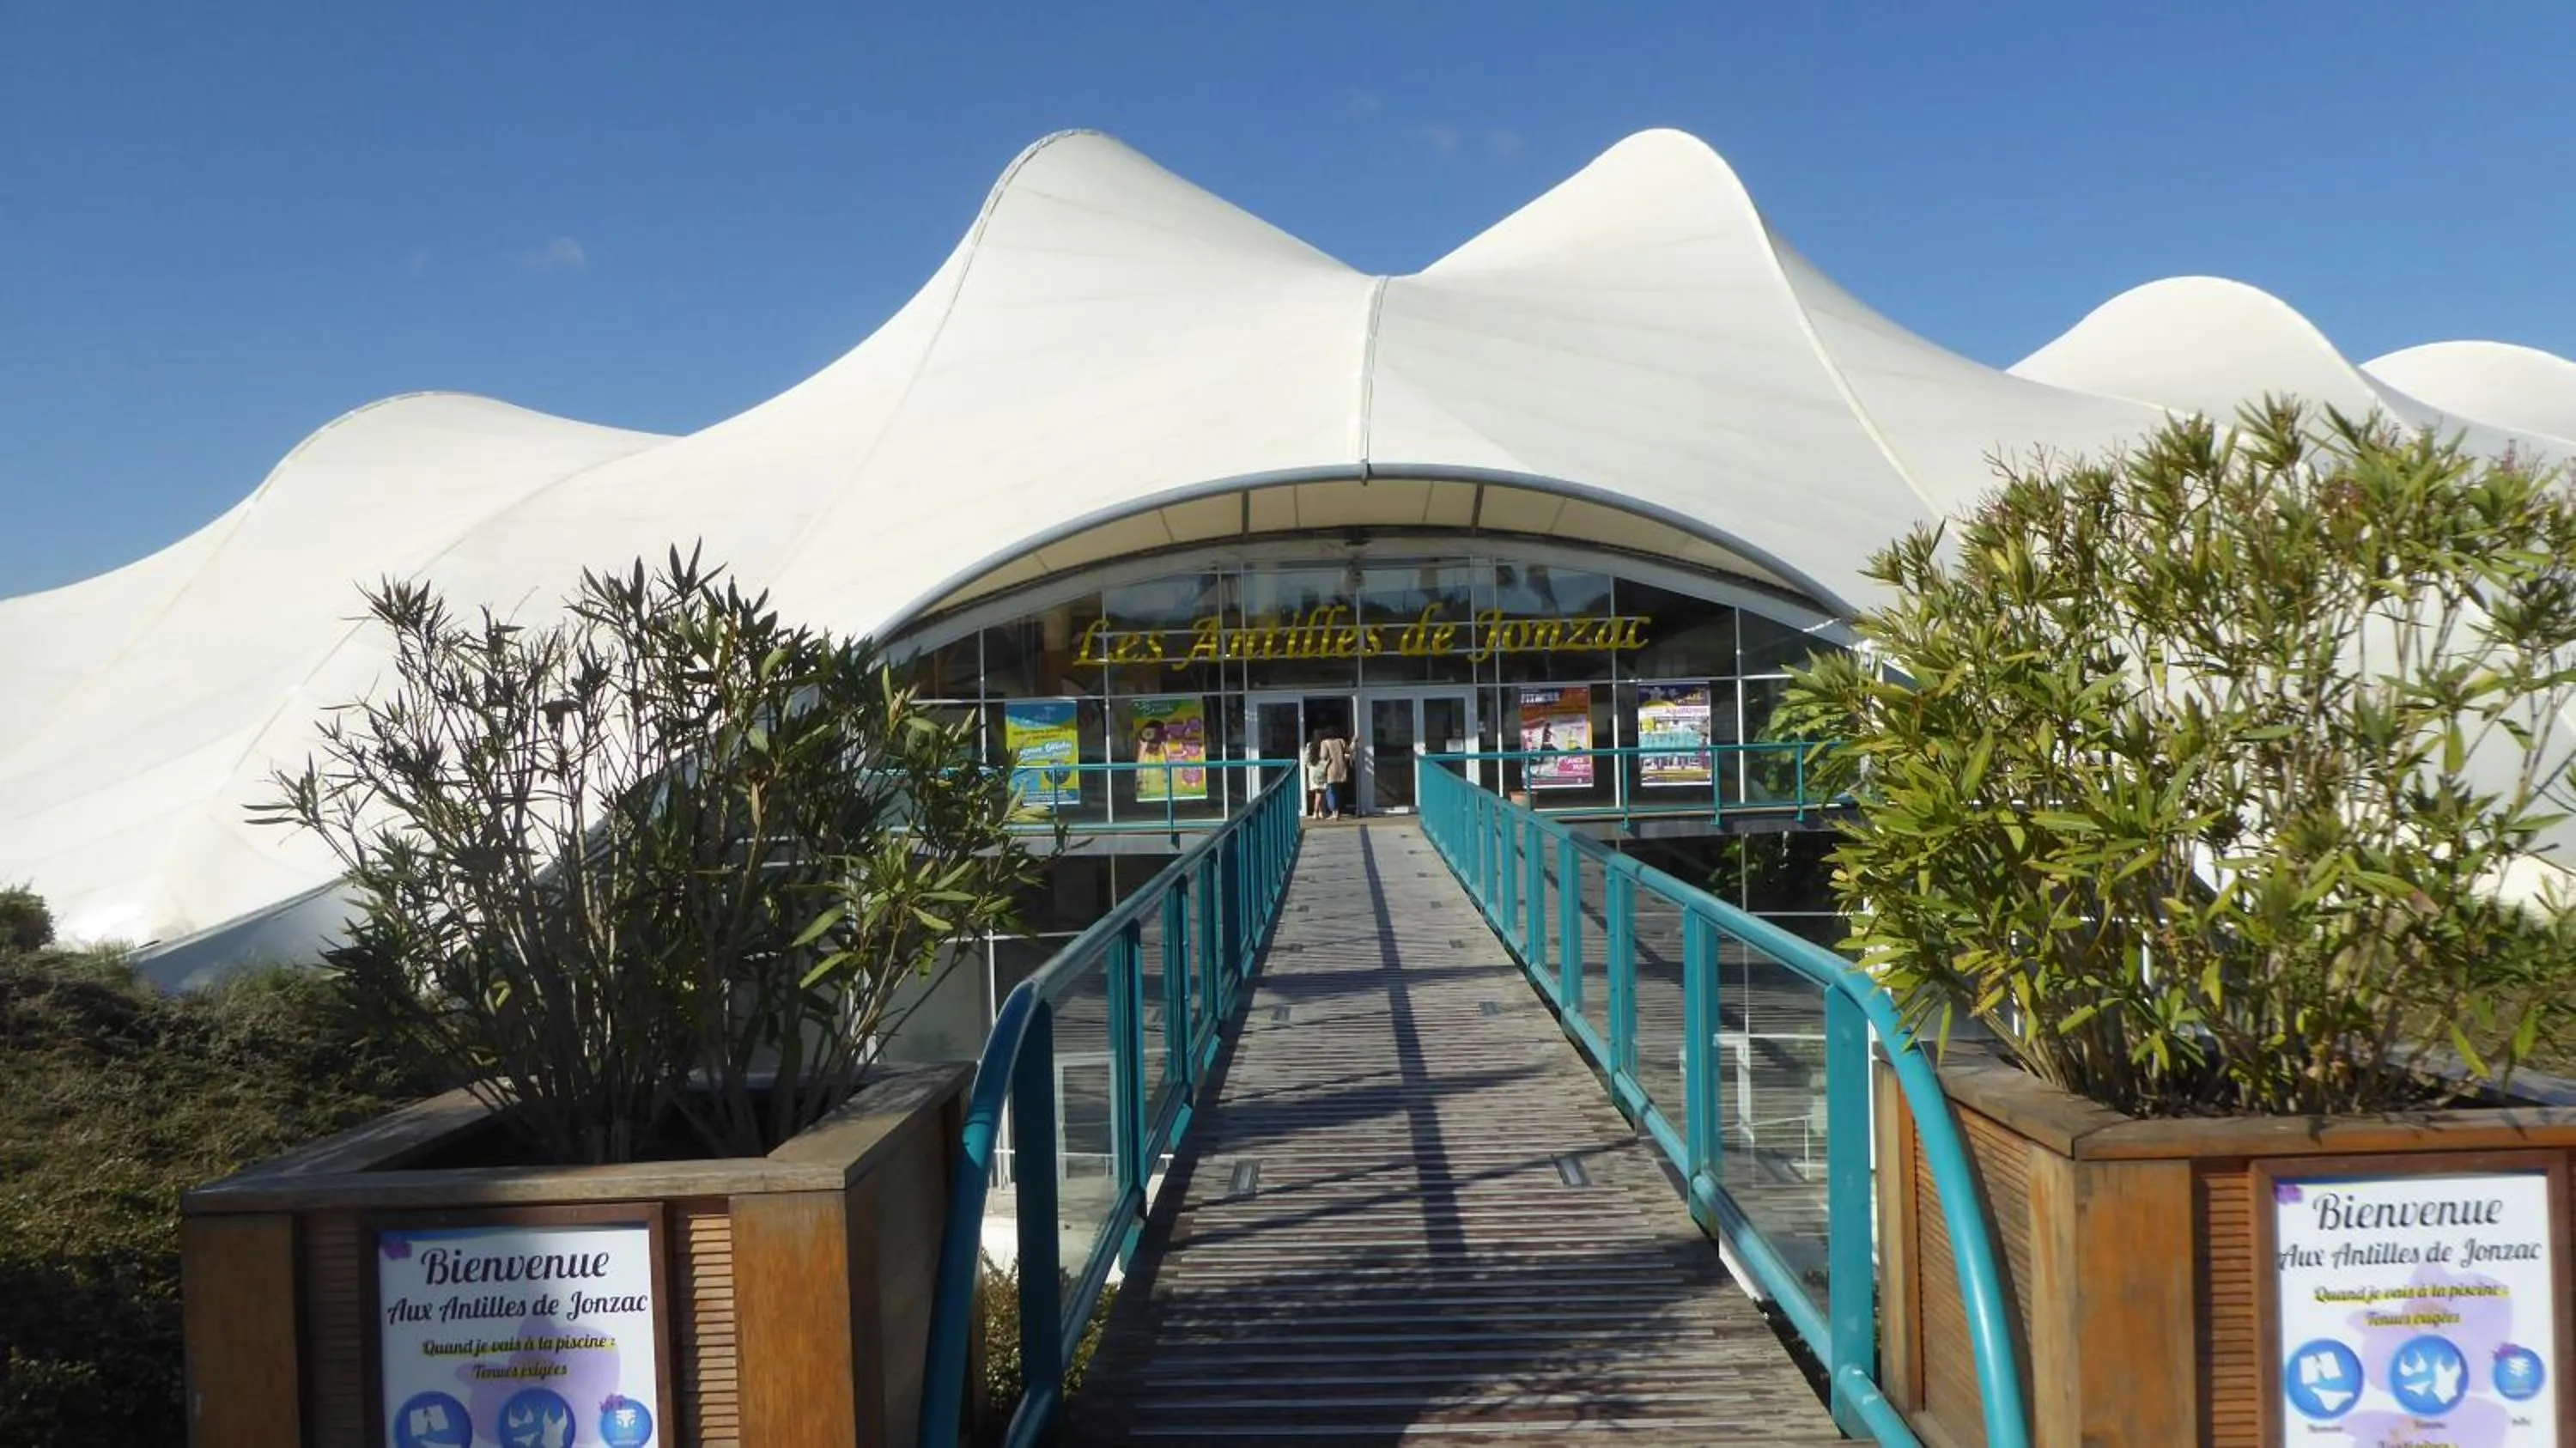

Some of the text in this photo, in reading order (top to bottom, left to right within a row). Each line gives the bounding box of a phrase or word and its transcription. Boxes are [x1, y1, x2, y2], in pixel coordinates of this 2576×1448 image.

[1073, 602, 1651, 671] Les Antilles de Jonzac
[2312, 1193, 2503, 1231] Bienvenue
[421, 1247, 610, 1285] Bienvenue
[2279, 1238, 2543, 1271] Aux Antilles de Jonzac
[387, 1290, 648, 1325] Aux Antilles de Jonzac
[2313, 1286, 2366, 1303] Quand
[422, 1339, 473, 1356] Quand
[472, 1340, 489, 1357] je
[490, 1338, 521, 1353] vais
[555, 1334, 606, 1354] piscine
